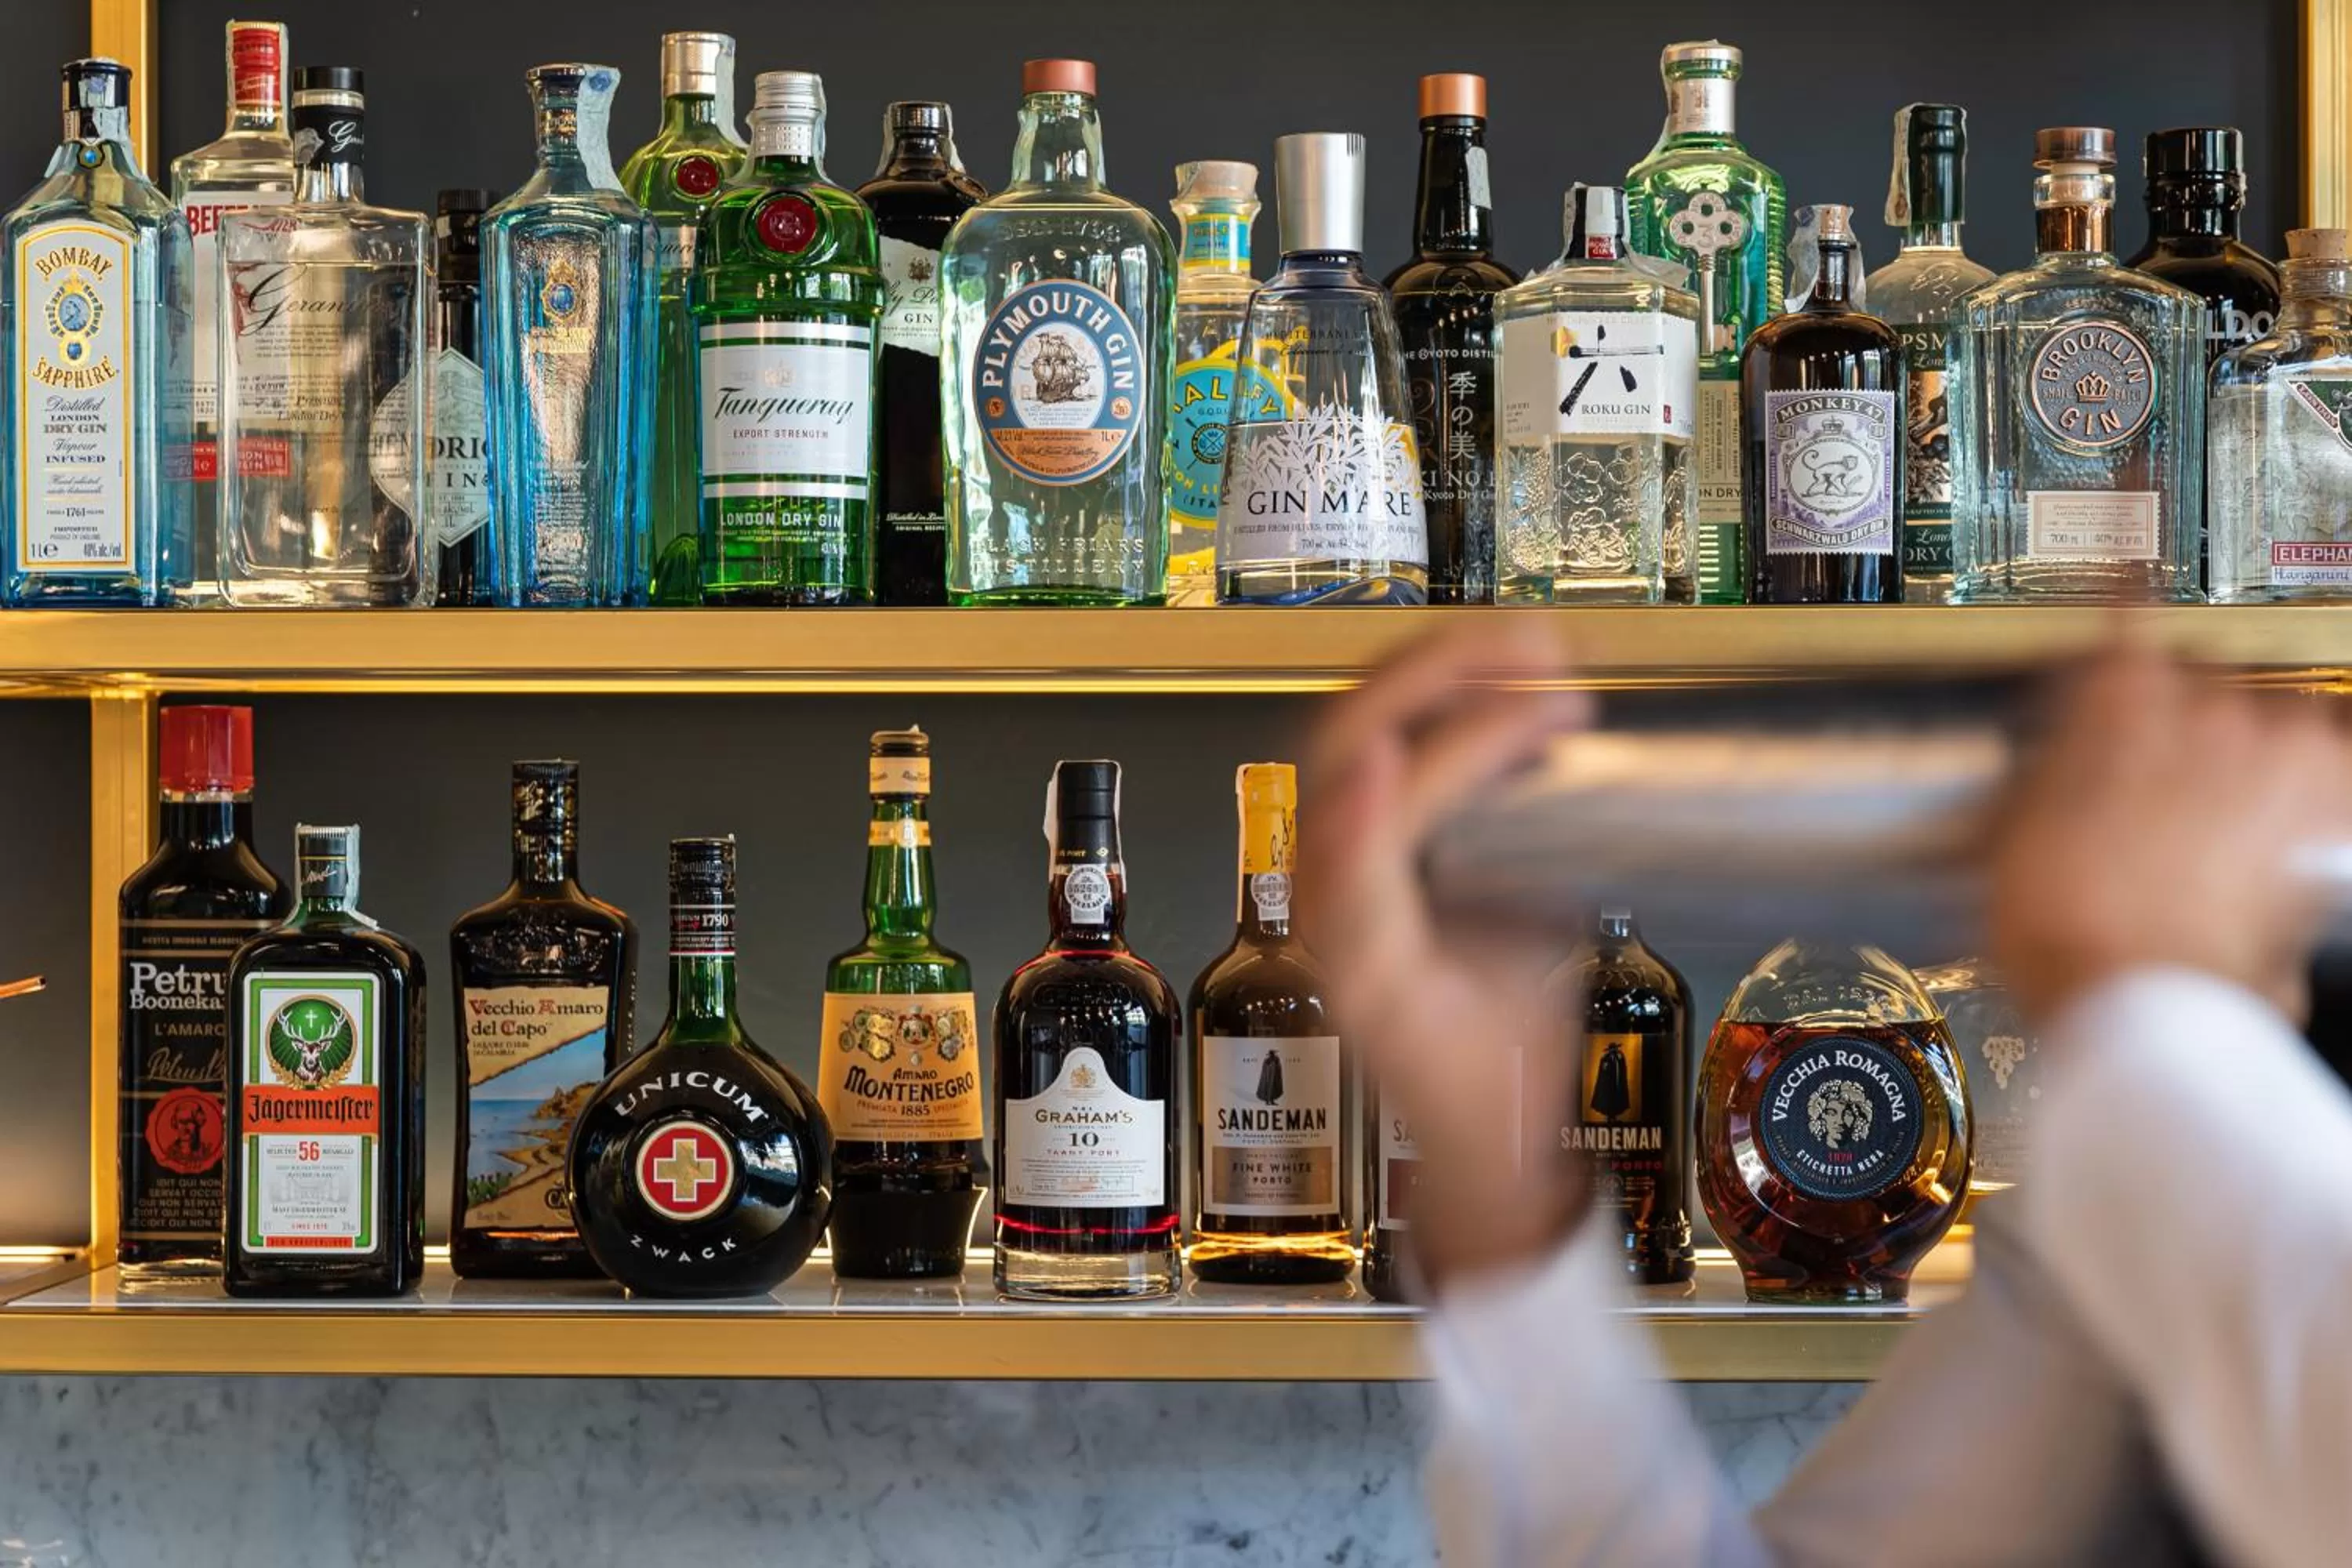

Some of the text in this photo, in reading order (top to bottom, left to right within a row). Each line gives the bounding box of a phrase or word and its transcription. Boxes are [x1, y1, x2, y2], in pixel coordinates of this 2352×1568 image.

[35, 247, 113, 275] BOMBAY
[904, 314, 932, 323] GIN
[982, 291, 1112, 389] PLYMOUTH
[1106, 333, 1135, 389] GIN
[2041, 332, 2147, 384] BROOKLYN
[31, 358, 115, 388] SAPPHIRE
[714, 387, 853, 424] Tanqueray
[1449, 371, 1477, 460] 季の美
[1581, 403, 1651, 415] ROKU GIN
[1779, 397, 1883, 420] MONKEY 47
[44, 424, 107, 434] DRY GIN
[2059, 407, 2122, 436] GIN
[733, 429, 829, 439] EXPORT STRENGTH
[1247, 491, 1412, 517] GIN MARE
[1425, 489, 1454, 502] Kyoto
[720, 512, 842, 528] LONDON DRY GIN
[1776, 519, 1849, 545] SCHWARZWALD
[1851, 528, 1869, 540] DRY
[702, 913, 729, 927] 1790
[129, 962, 226, 995] Petru
[129, 993, 225, 1010] Booneka
[469, 999, 604, 1016] Vecchio Amaro
[471, 1021, 547, 1040] del Capo
[844, 1065, 975, 1103] MONTENEGRO
[1772, 1050, 1907, 1123] VECCHIA ROMAGNA
[615, 1071, 768, 1123] UNICUM
[902, 1104, 931, 1116] 1885
[1036, 1109, 1134, 1123] GRAHAM'S
[1218, 1107, 1326, 1131] SANDEMAN
[1069, 1132, 1099, 1147] 10
[1560, 1127, 1662, 1151] SANDEMAN
[299, 1141, 320, 1161] 56
[1857, 1149, 1885, 1172] NERA
[1232, 1162, 1312, 1174] FINE WHITE
[547, 1190, 568, 1208] CA
[630, 1233, 738, 1264] ZWACK
